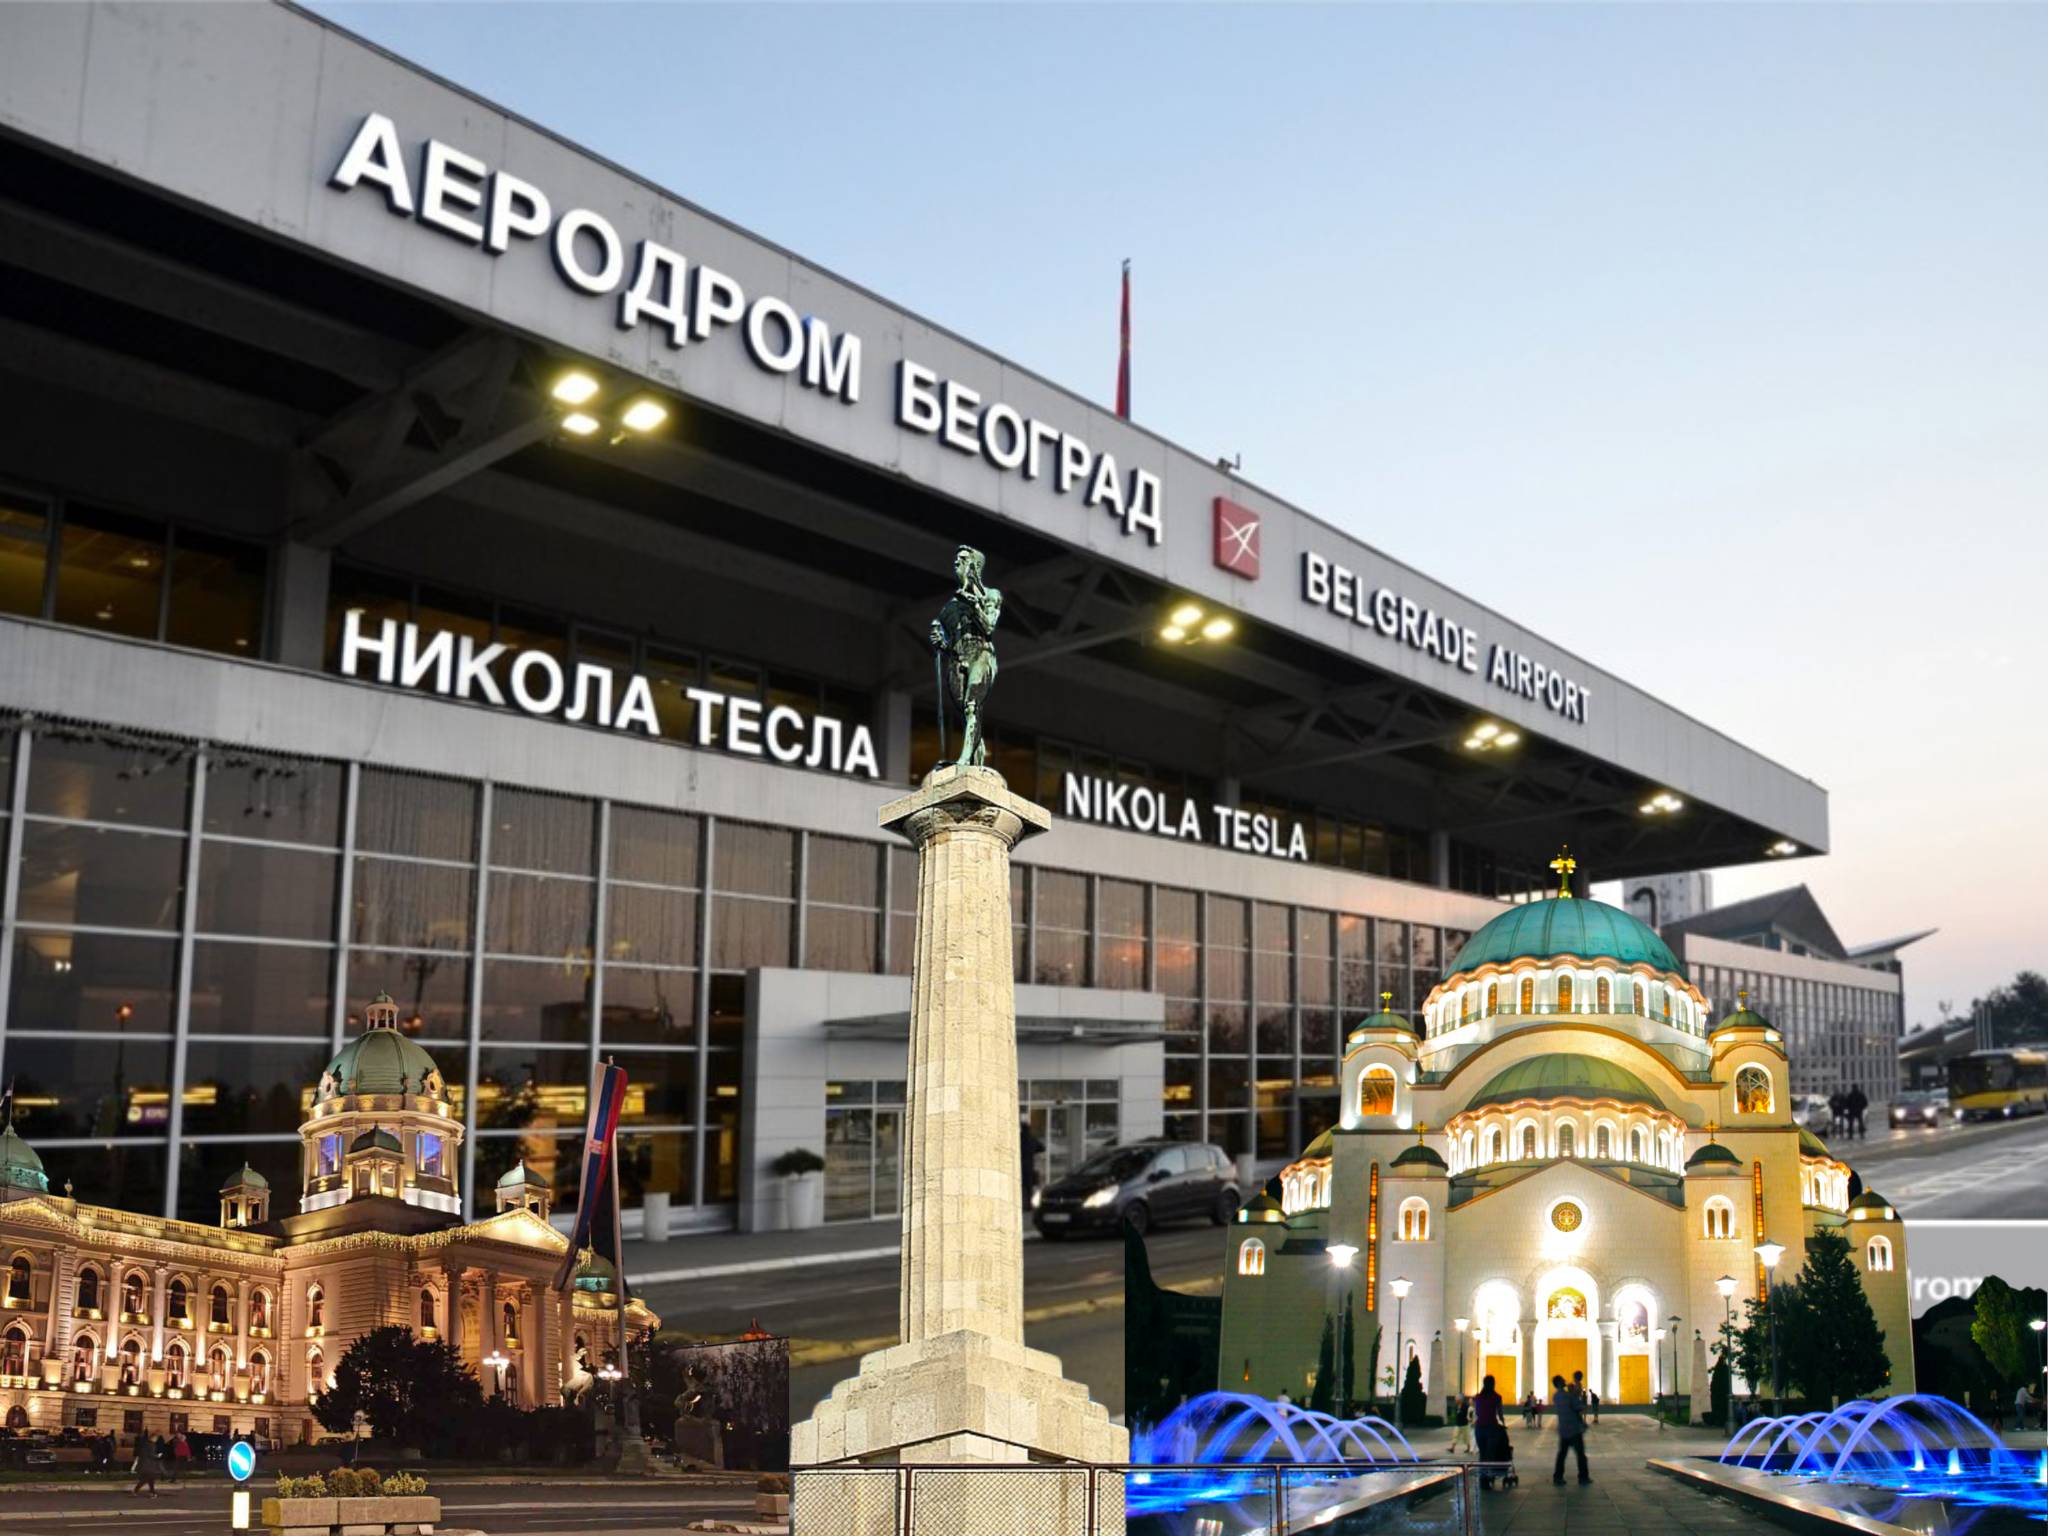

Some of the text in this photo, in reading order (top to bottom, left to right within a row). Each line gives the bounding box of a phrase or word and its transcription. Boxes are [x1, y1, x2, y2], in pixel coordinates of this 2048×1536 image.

[329, 112, 1164, 547] АЕРОДРОМ БЕОГРАД
[341, 609, 881, 778] НИКОЛА ТЕСЛА
[1302, 551, 1592, 724] BELGRADE AIRPORT
[1066, 771, 1308, 861] NIKOLA TESLA
